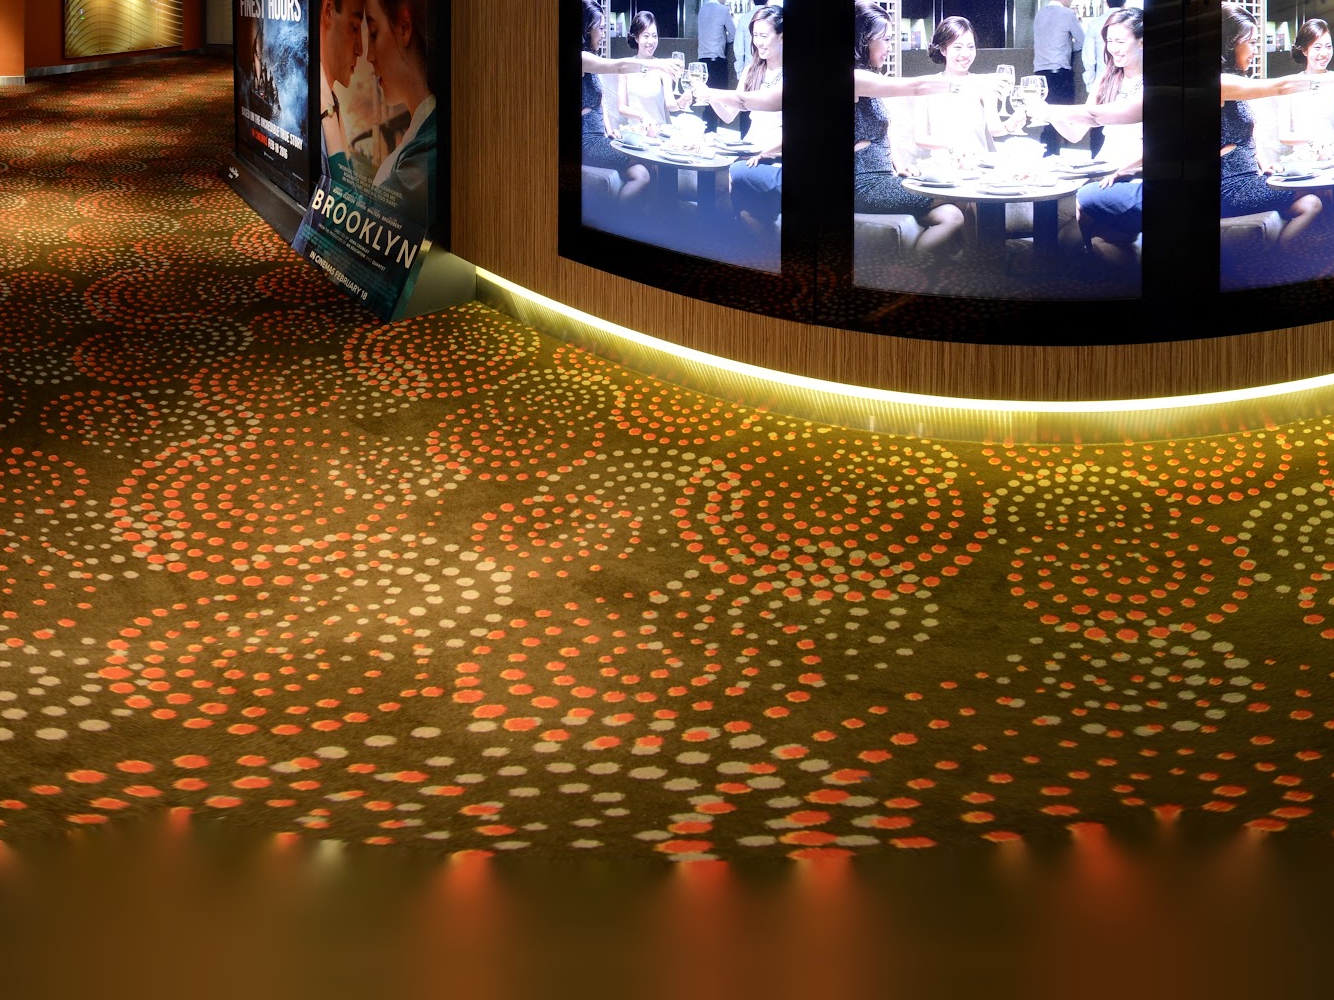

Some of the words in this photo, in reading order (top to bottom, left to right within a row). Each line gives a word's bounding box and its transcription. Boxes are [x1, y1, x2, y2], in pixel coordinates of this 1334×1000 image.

[311, 188, 418, 270] BROOKLYN
[309, 250, 317, 260] IN
[314, 255, 336, 275] CINEMAS
[334, 270, 362, 295] FEBRUARY
[360, 290, 368, 301] 18
